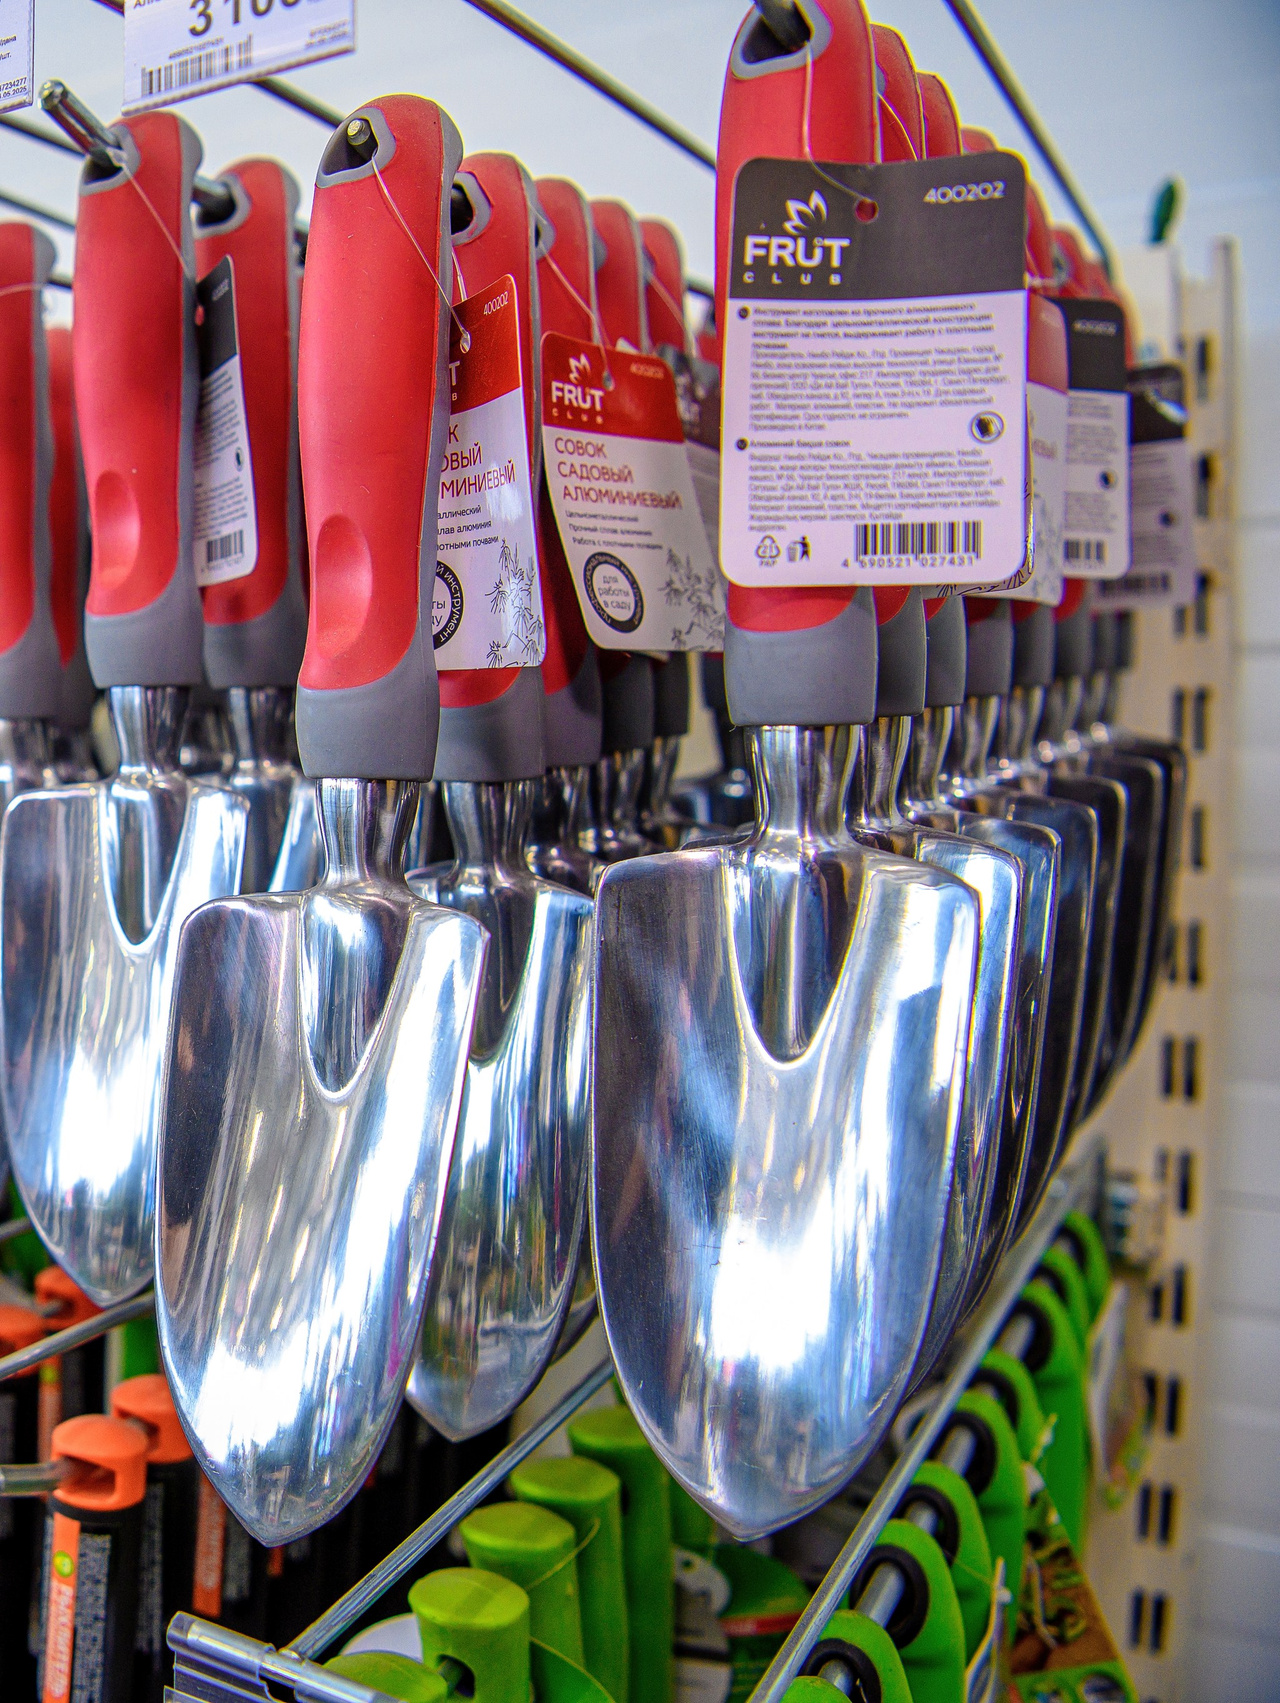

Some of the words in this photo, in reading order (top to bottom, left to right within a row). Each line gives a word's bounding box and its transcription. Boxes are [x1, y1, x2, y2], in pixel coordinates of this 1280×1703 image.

[923, 180, 1007, 203] 400202
[483, 291, 509, 316] 400202
[551, 381, 604, 412] FRUT
[554, 437, 606, 459] СОВОК
[441, 459, 516, 499] МИНИЕВЫЙ
[557, 461, 634, 484] САДОВЫЙ
[563, 485, 683, 510] АЛЮМИНИЕВЫЙ
[457, 520, 491, 533] алюминия
[472, 536, 498, 547] почвами
[841, 557, 850, 568] 4
[859, 556, 913, 568] 690521
[920, 554, 975, 567] 027431
